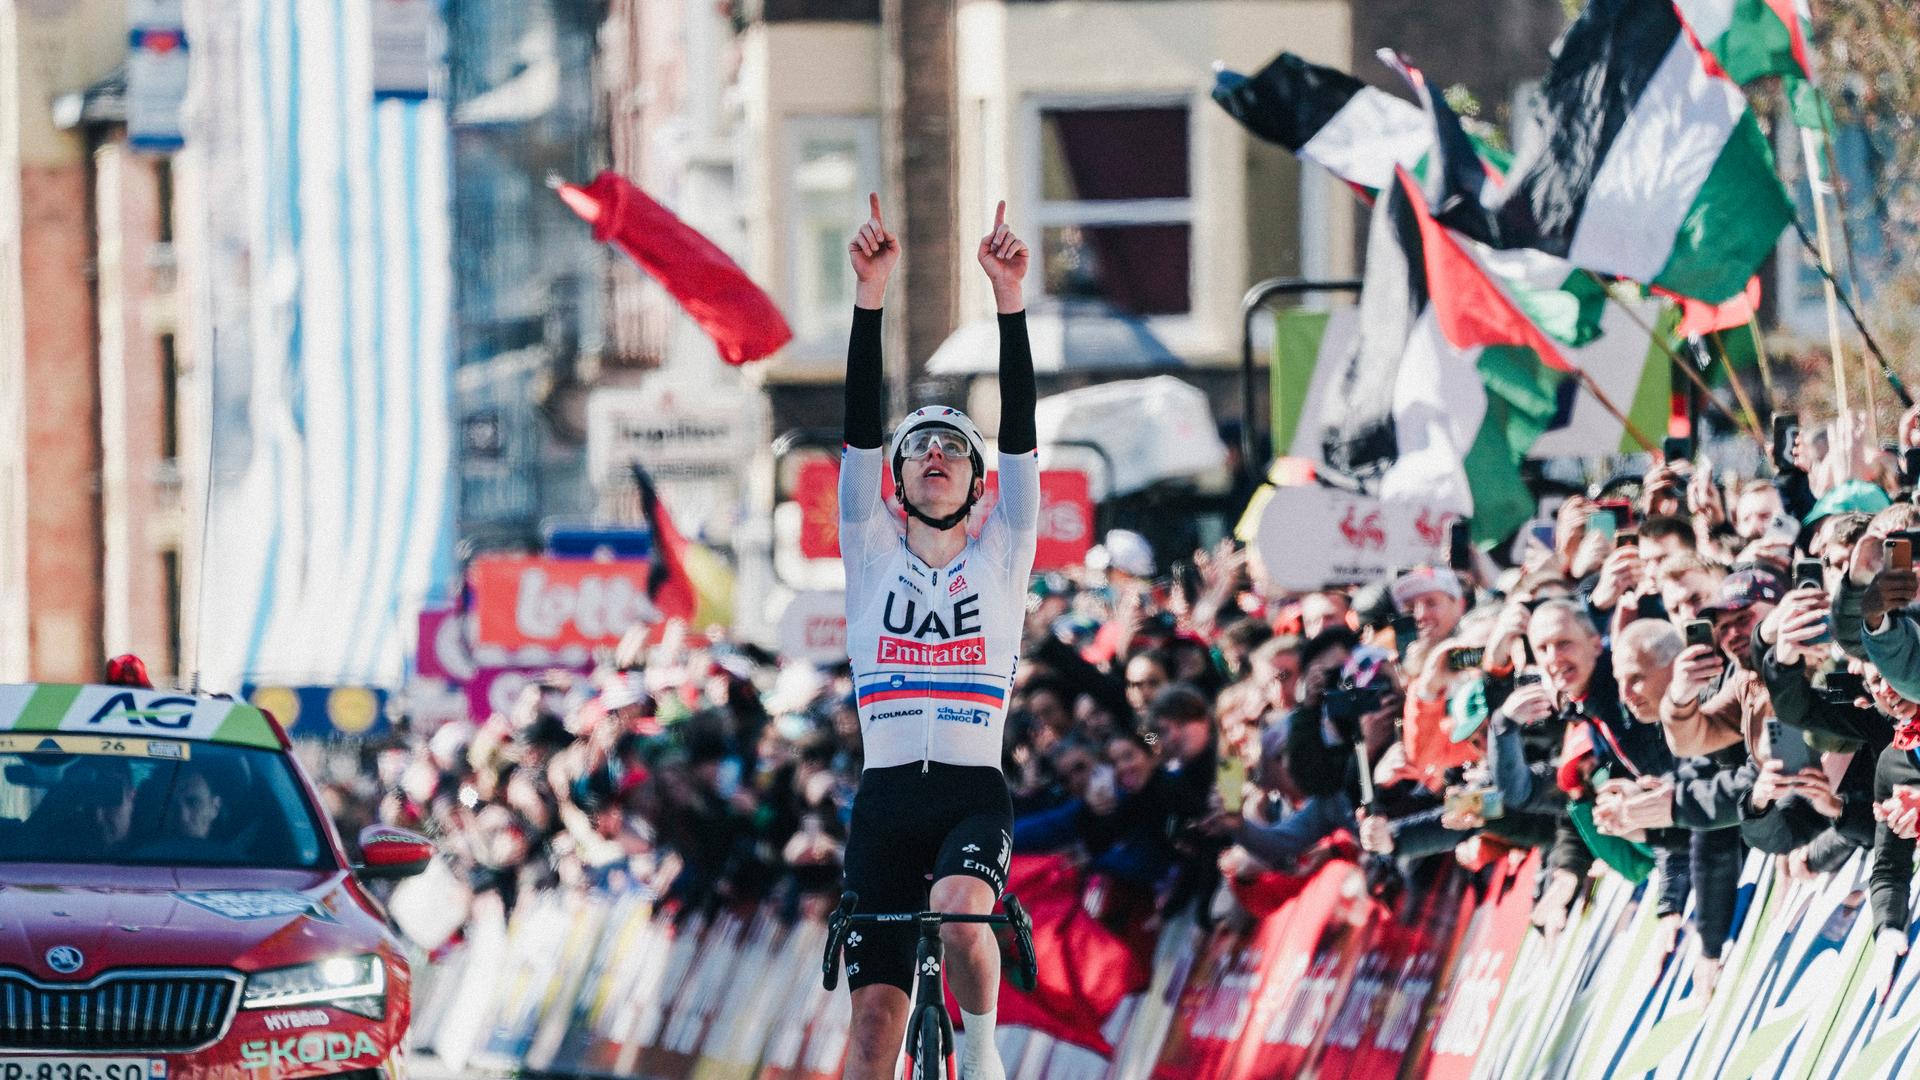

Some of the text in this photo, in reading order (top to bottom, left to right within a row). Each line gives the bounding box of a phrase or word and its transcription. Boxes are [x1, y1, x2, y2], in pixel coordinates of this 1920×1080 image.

[882, 591, 982, 640] UAE
[880, 640, 983, 665] Emirates
[88, 692, 197, 729] AG
[877, 709, 923, 720] COLNAGO
[937, 714, 972, 723] ADNOC
[101, 740, 126, 752] 26
[263, 1010, 329, 1031] HYBRID
